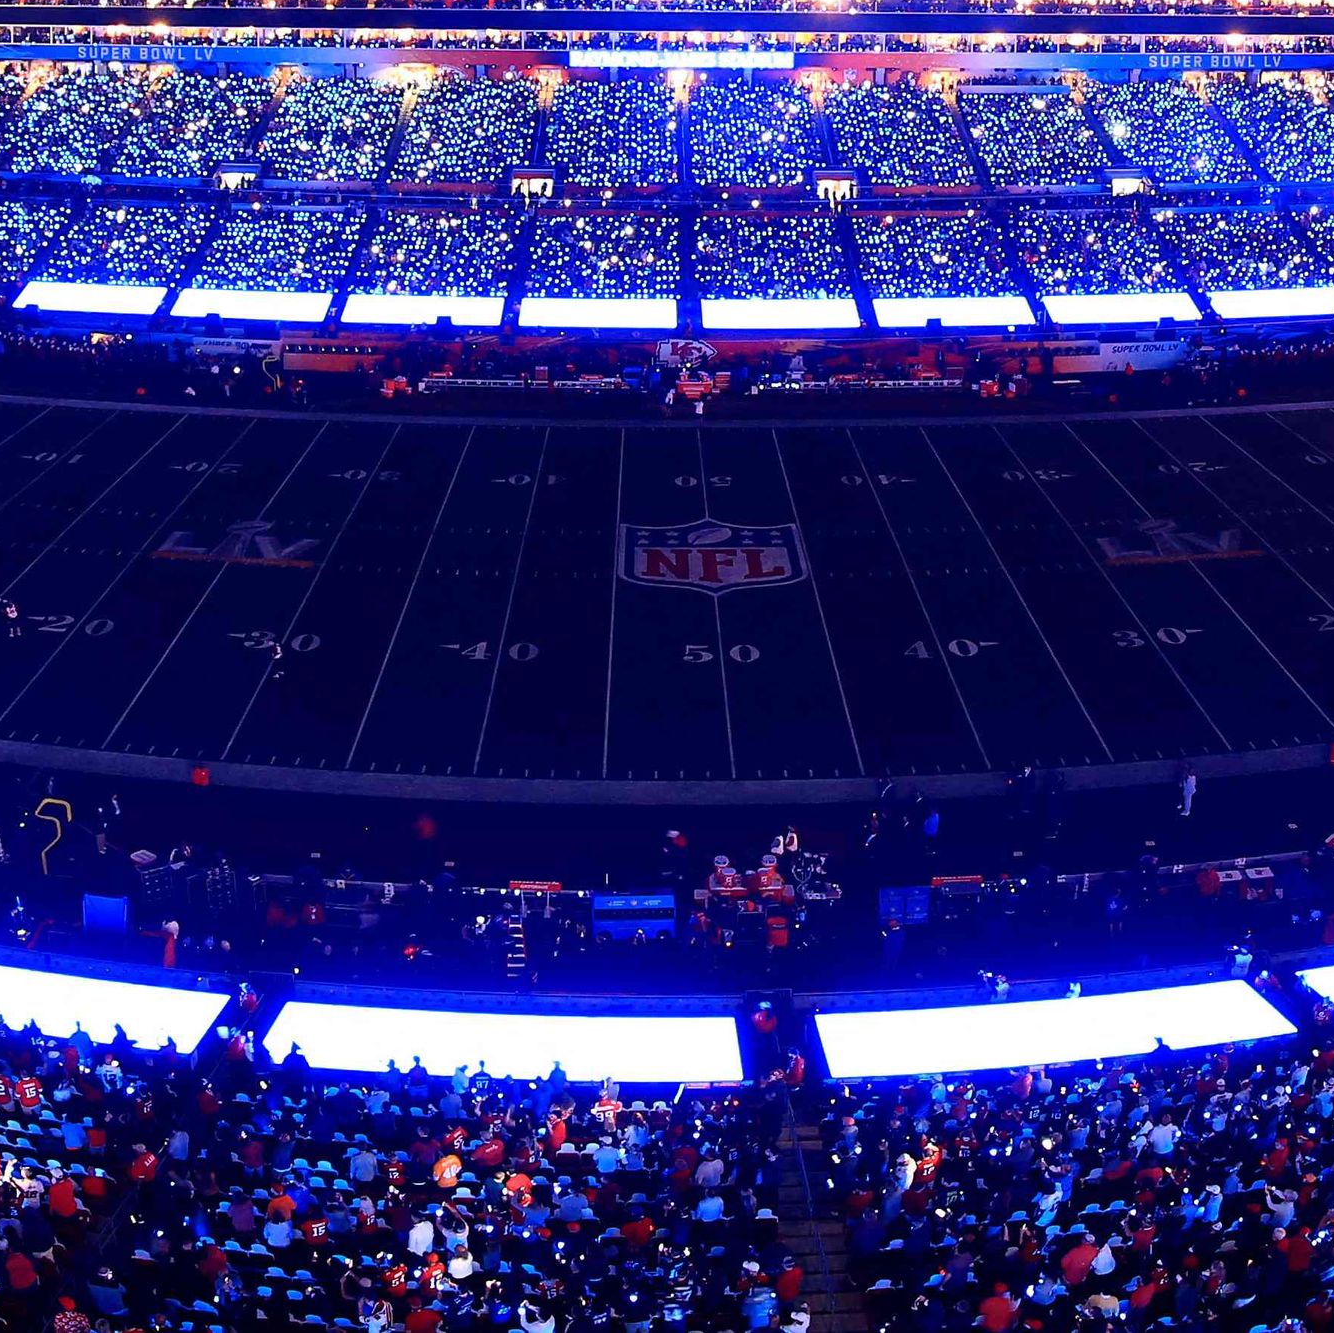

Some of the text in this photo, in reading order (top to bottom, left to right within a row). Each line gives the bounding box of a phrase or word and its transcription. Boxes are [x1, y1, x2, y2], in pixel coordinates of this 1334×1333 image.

[78, 46, 214, 60] SUPER BOWL LV
[1148, 55, 1282, 68] SUPER BOWL LV
[1112, 343, 1179, 354] SUPER BOWL LV
[641, 549, 785, 583] NFL
[37, 614, 114, 637] 20
[244, 630, 322, 652] 30
[1112, 627, 1187, 648] 30
[462, 641, 540, 662] 40
[682, 644, 761, 664] 50
[903, 638, 979, 659] 40
[24, 1087, 38, 1099] 15
[312, 1226, 326, 1238] 15
